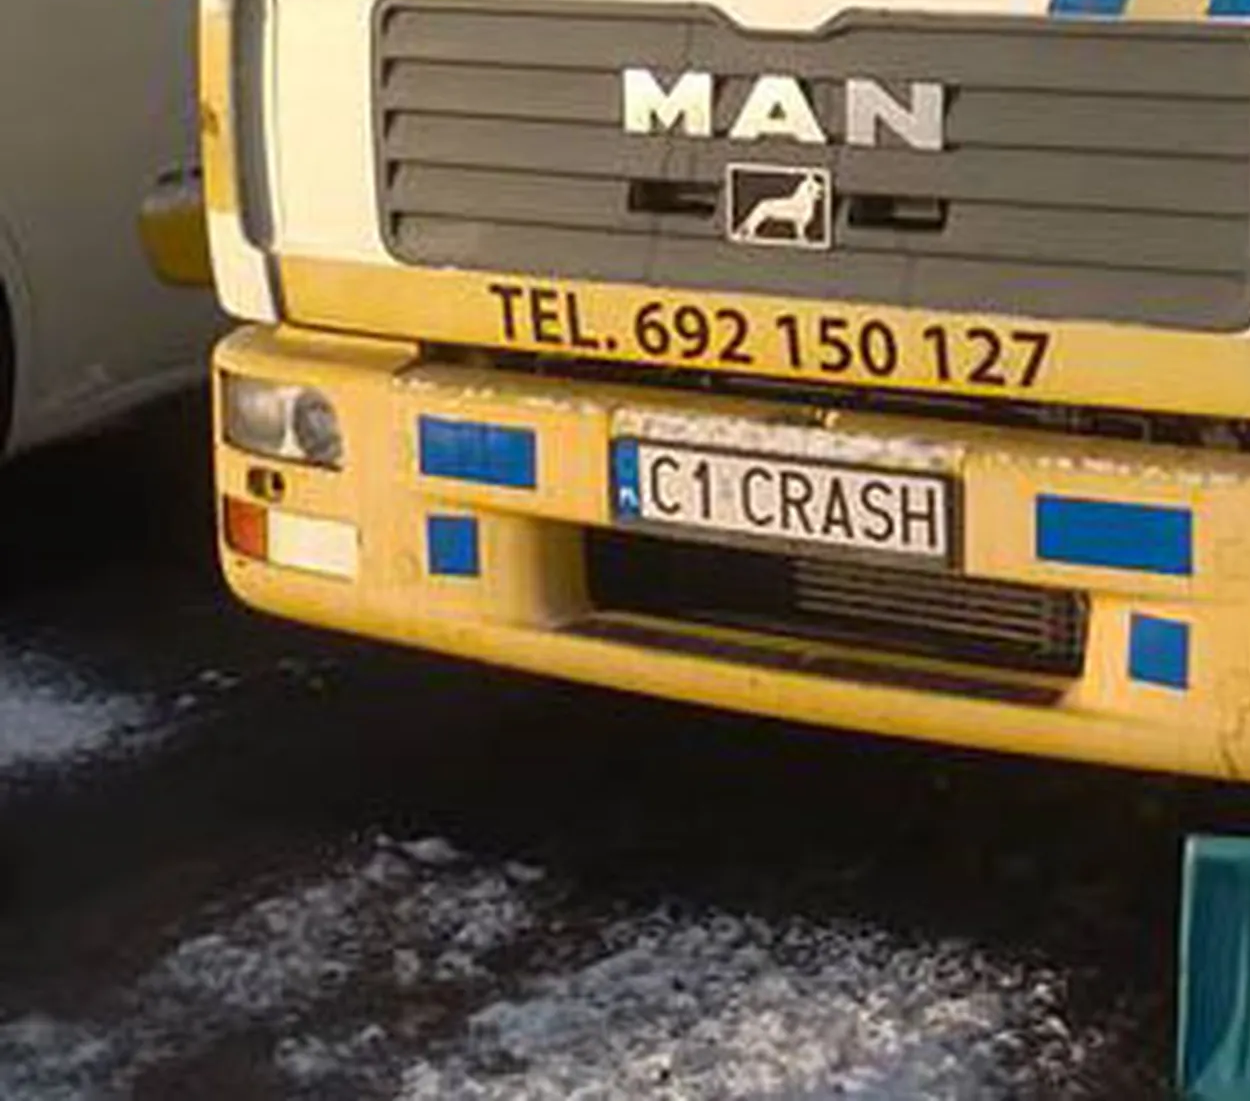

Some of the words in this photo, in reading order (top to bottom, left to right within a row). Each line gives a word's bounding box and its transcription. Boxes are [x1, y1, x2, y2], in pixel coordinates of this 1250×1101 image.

[622, 67, 945, 151] MAN
[489, 283, 618, 352] TEL.
[634, 301, 752, 365] 692
[776, 314, 898, 379] 150
[923, 327, 1051, 388] 127
[649, 456, 711, 520] C1
[741, 466, 938, 548] CRASH
